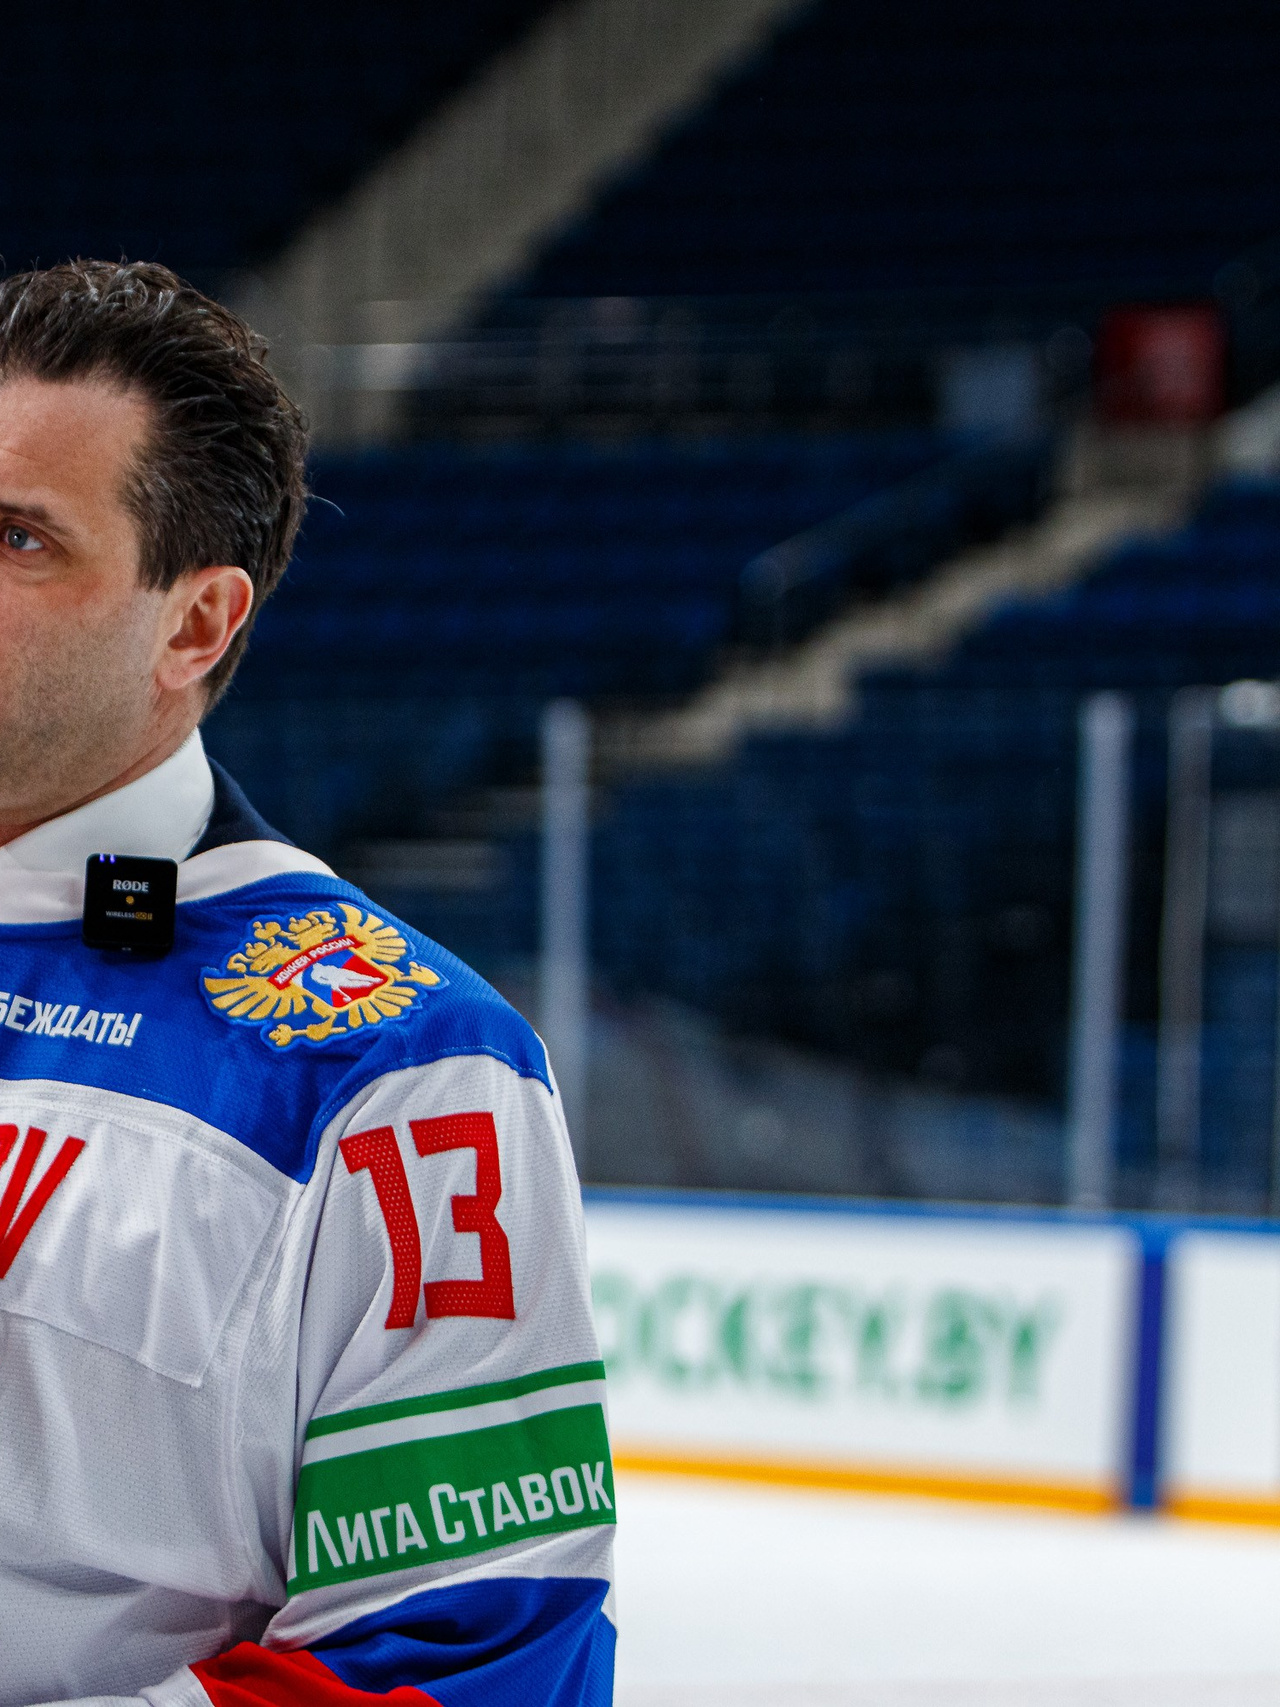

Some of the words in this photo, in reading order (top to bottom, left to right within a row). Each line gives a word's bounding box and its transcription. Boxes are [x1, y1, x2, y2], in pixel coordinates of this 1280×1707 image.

[113, 879, 149, 893] RØDE
[274, 955, 312, 984] ХОККЕЙ
[308, 938, 355, 962] РОССИИ
[339, 1112, 515, 1330] 13
